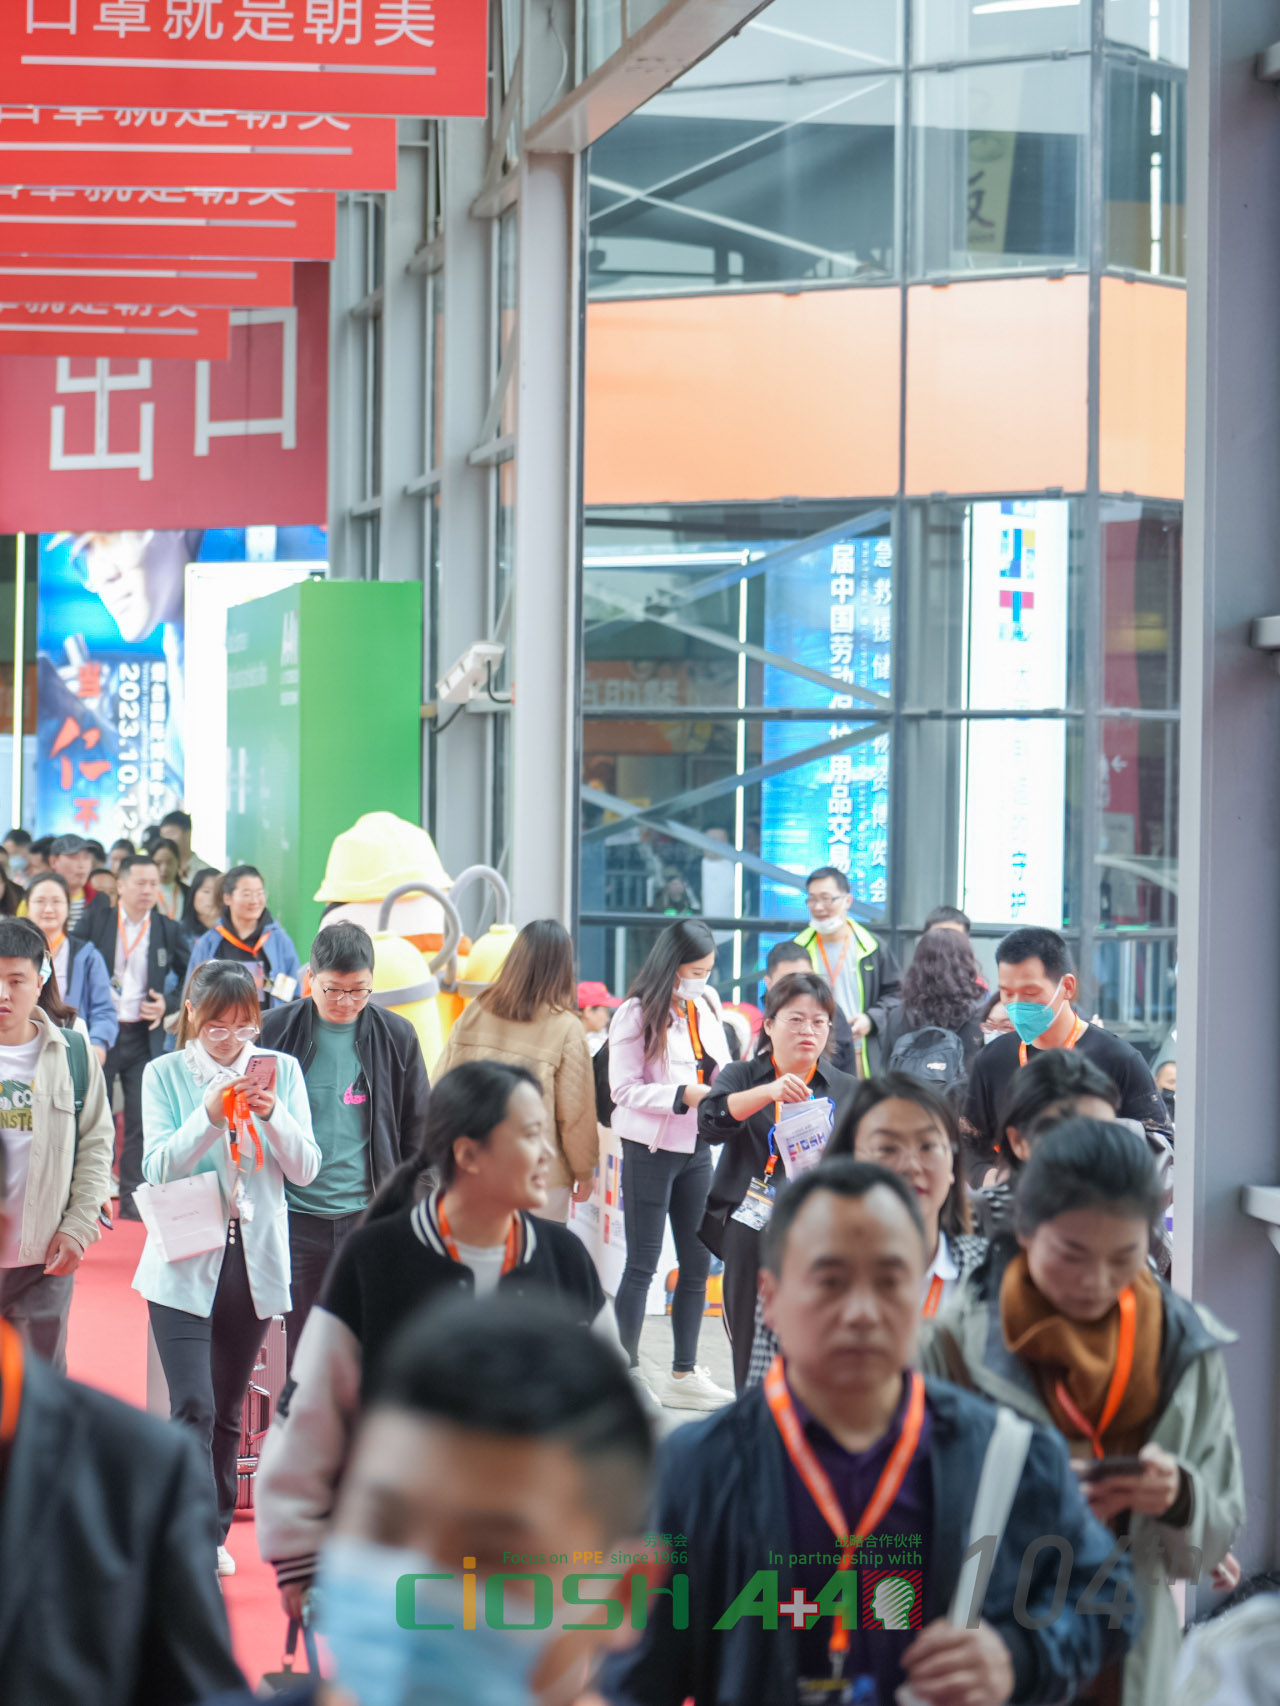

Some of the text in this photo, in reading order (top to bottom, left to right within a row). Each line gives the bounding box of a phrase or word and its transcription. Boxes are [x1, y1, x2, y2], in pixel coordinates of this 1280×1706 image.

[24, 0, 436, 47] 口罩就是朝美
[49, 307, 297, 481] 出口
